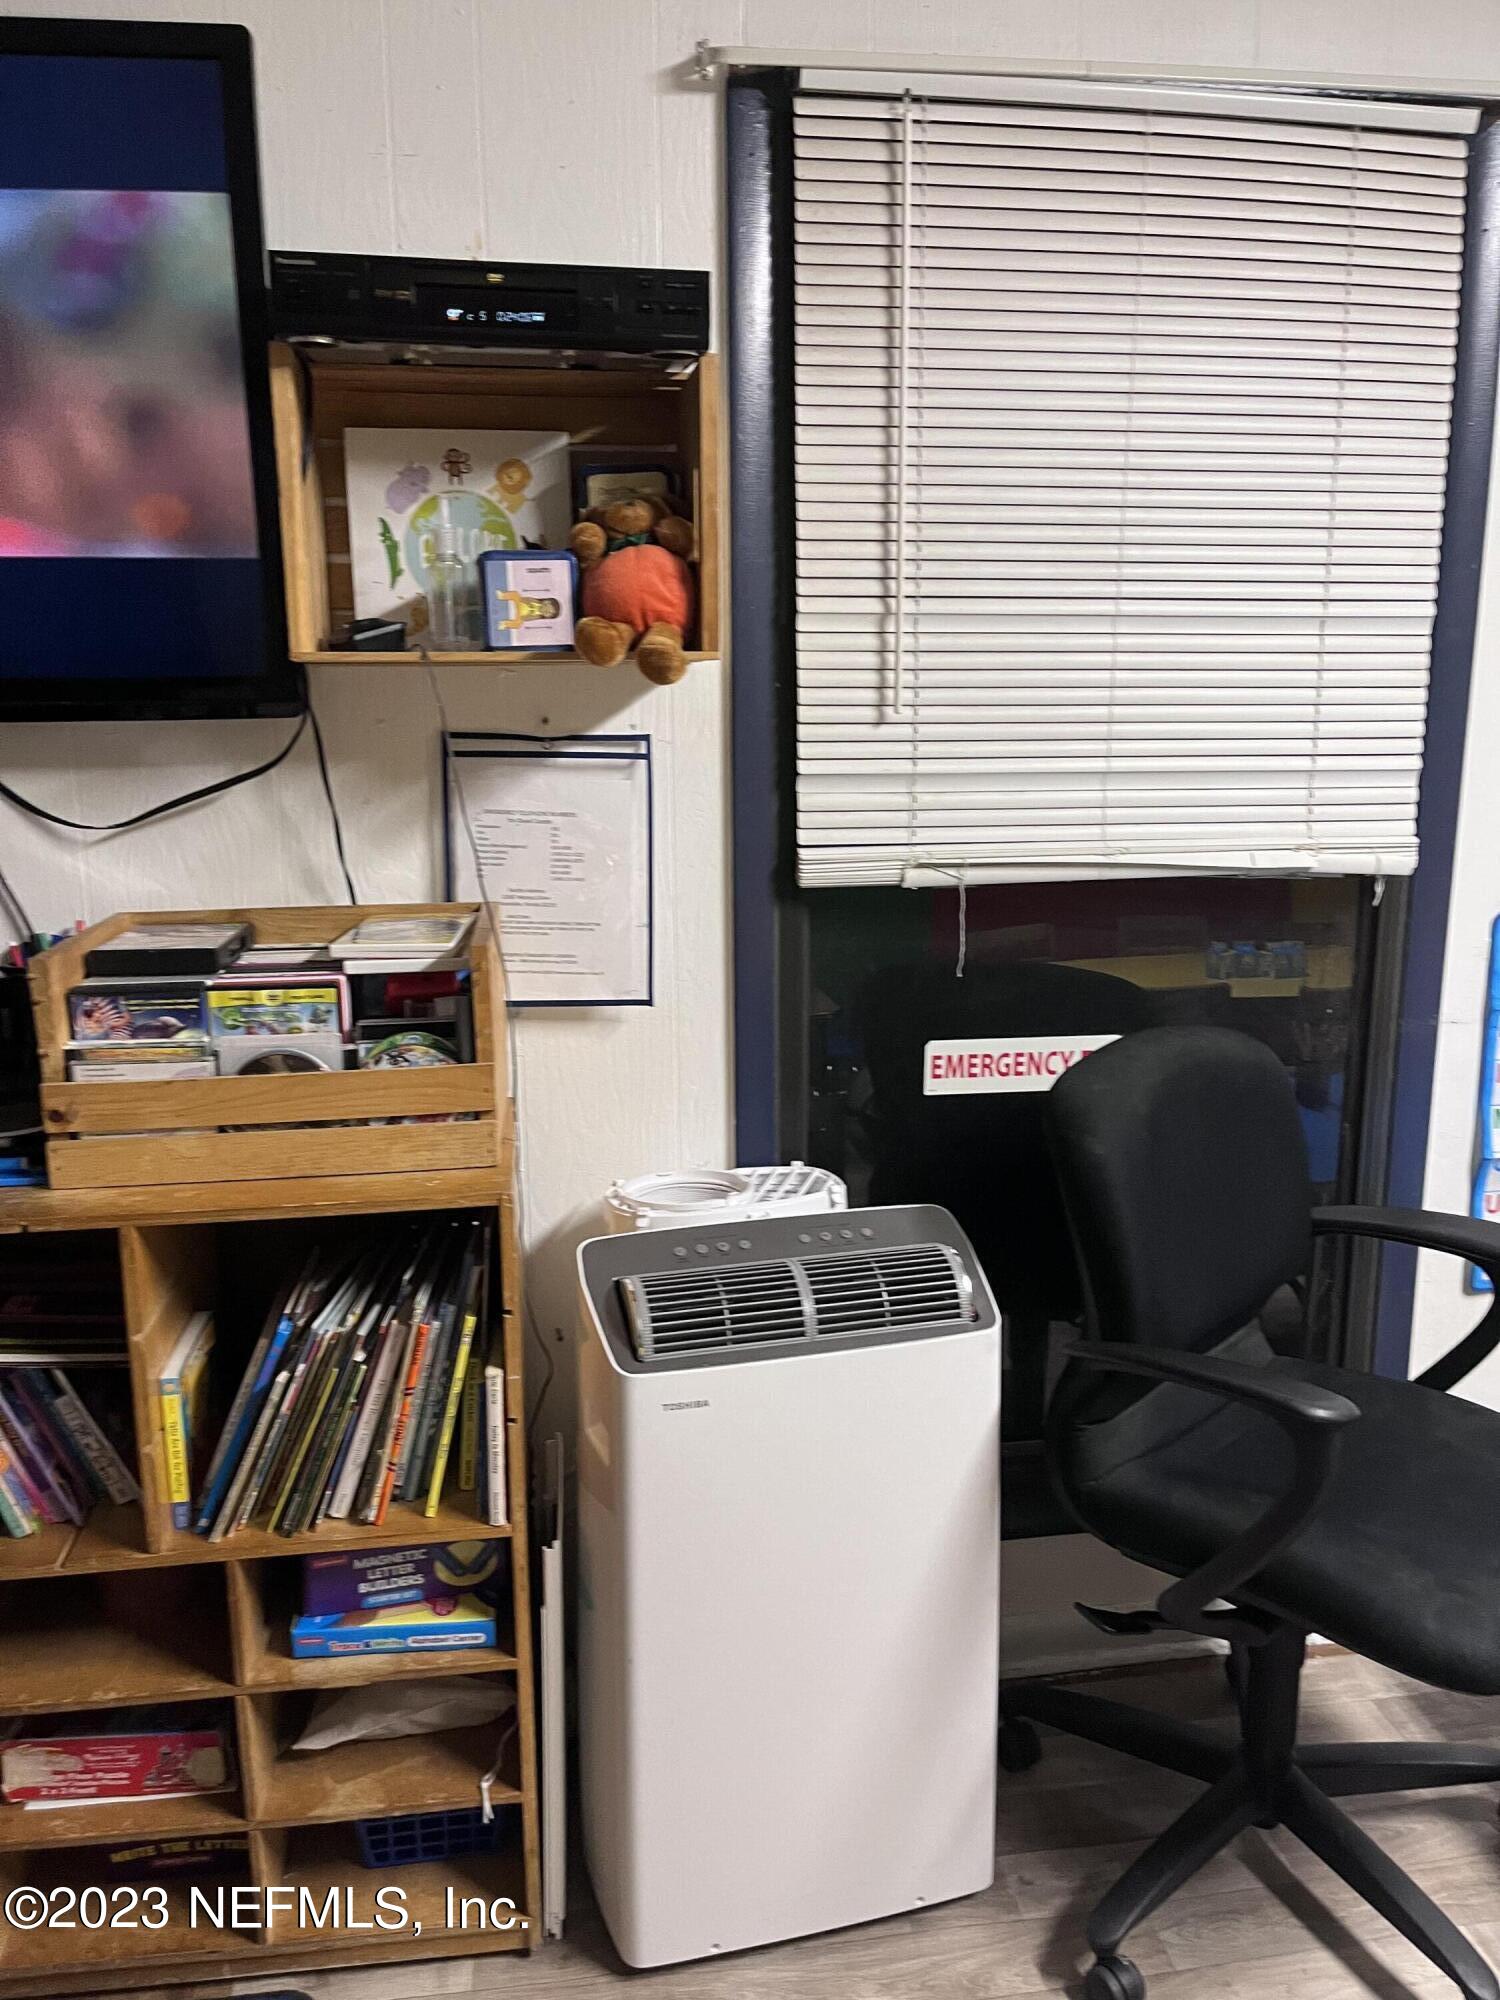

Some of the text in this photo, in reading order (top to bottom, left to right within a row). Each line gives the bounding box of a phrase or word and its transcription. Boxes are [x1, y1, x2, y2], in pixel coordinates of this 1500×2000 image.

[931, 1050, 1074, 1079] EMERGENCY
[352, 1549, 428, 1569] MAGNETIC
[366, 1563, 415, 1579] LETTER
[357, 1574, 424, 1593] BUILDERS
